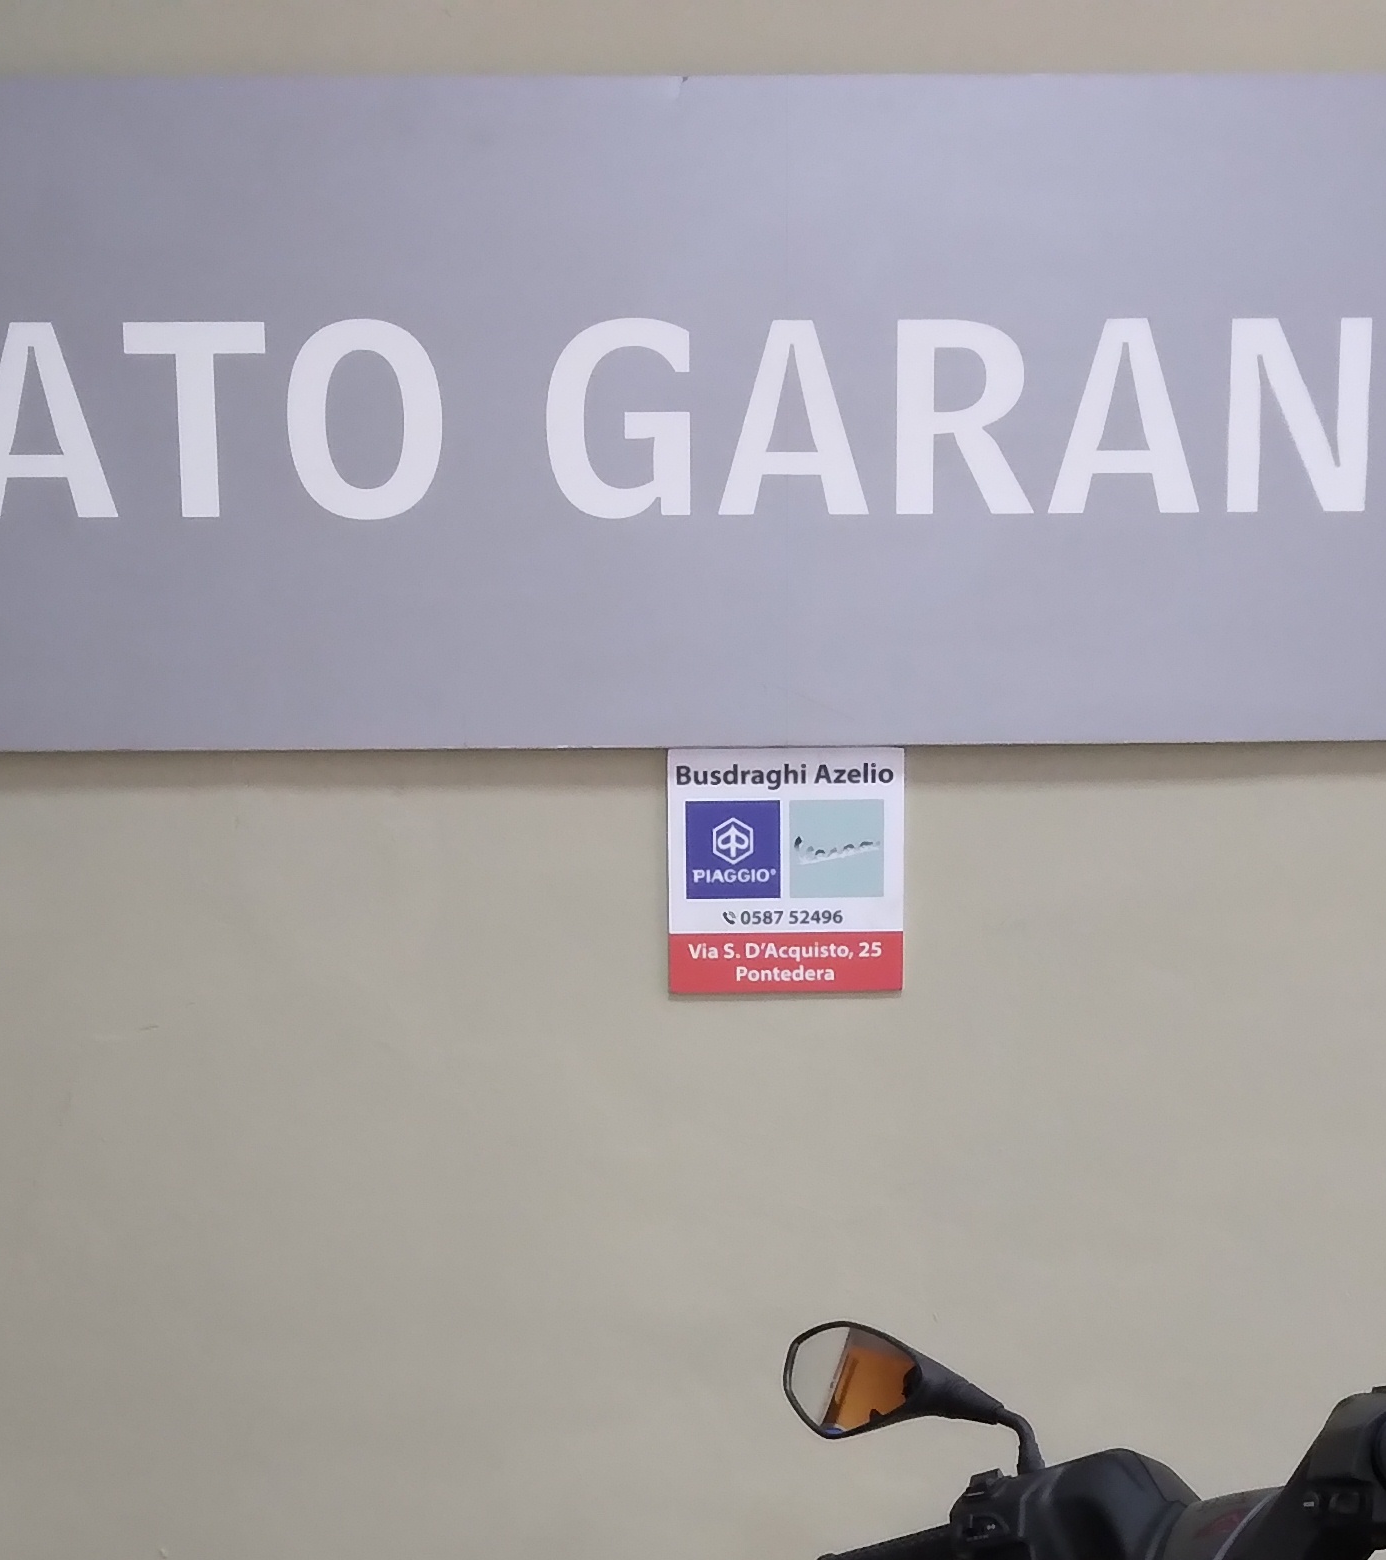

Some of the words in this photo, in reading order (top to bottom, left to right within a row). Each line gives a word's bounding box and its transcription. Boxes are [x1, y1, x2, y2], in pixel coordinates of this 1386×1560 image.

[675, 763, 807, 791] Busdraghi
[813, 762, 894, 785] Azelio
[740, 910, 784, 925] 0587
[788, 909, 844, 925] 52496
[688, 942, 719, 960] Via
[723, 942, 742, 960] S.
[858, 941, 883, 958] 25
[735, 964, 836, 983] Pontedera
